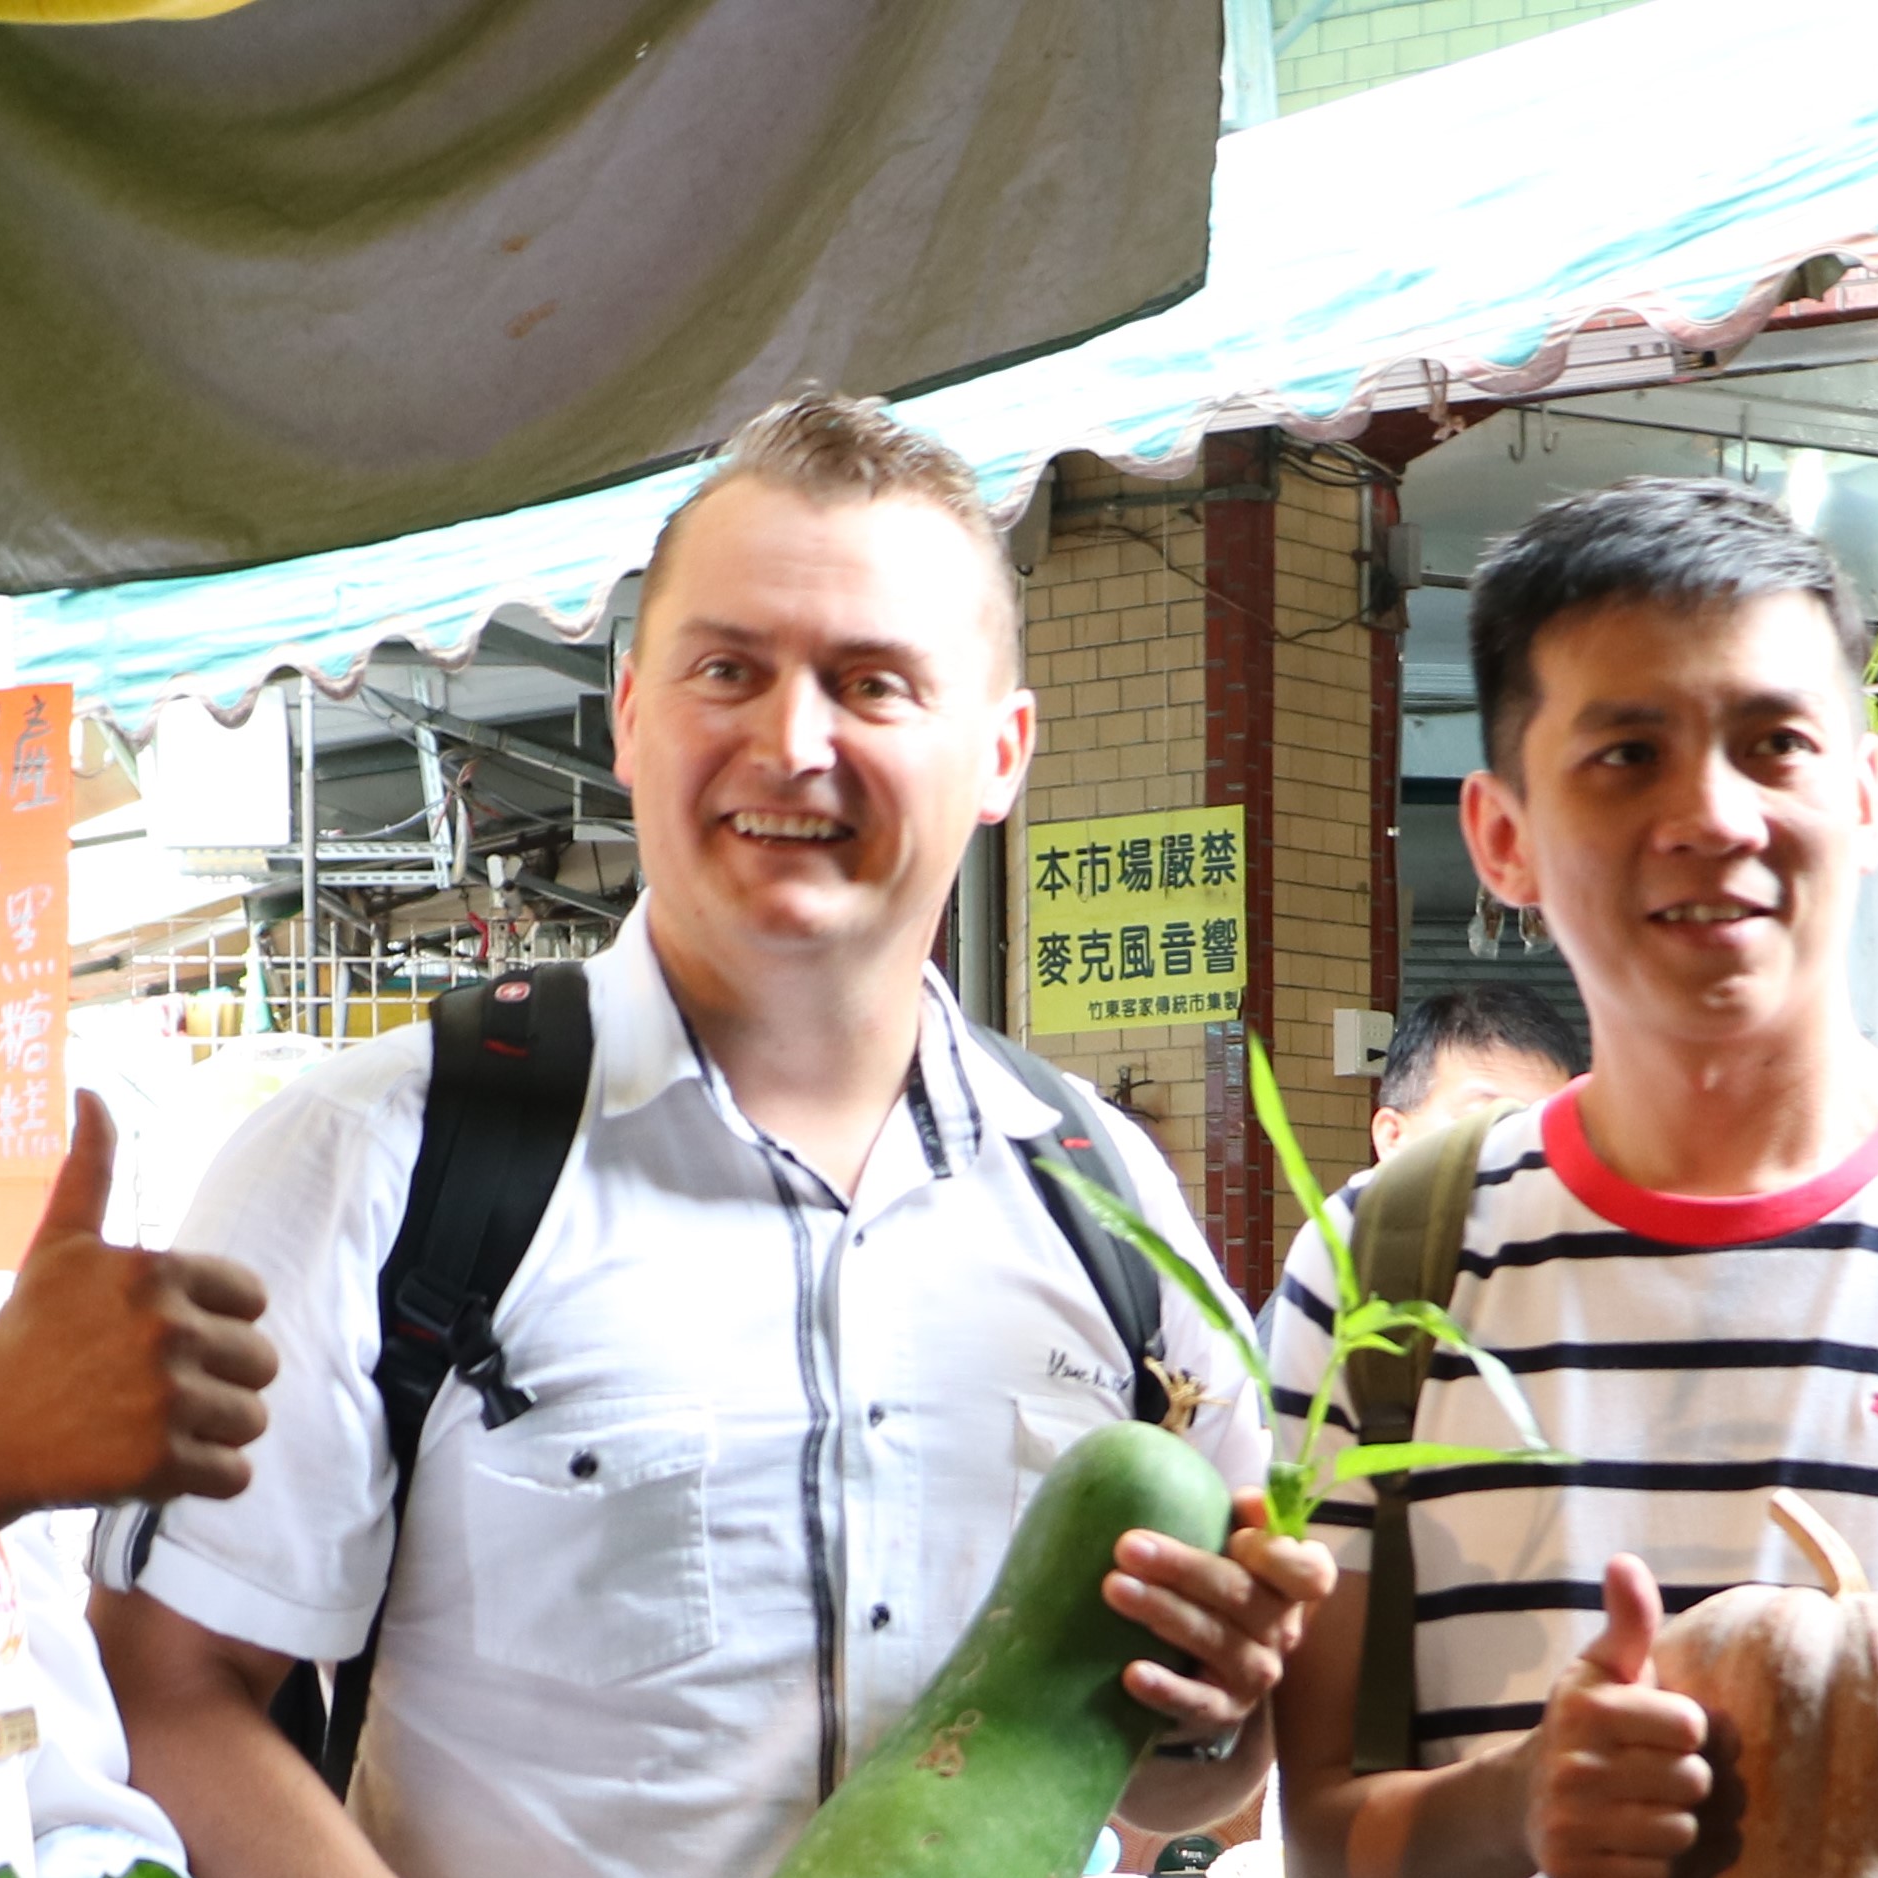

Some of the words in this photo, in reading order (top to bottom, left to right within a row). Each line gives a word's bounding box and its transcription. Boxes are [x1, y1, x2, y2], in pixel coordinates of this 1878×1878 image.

[1035, 829, 1237, 901] 本市場嚴禁
[1037, 917, 1238, 988] 麥克風音響
